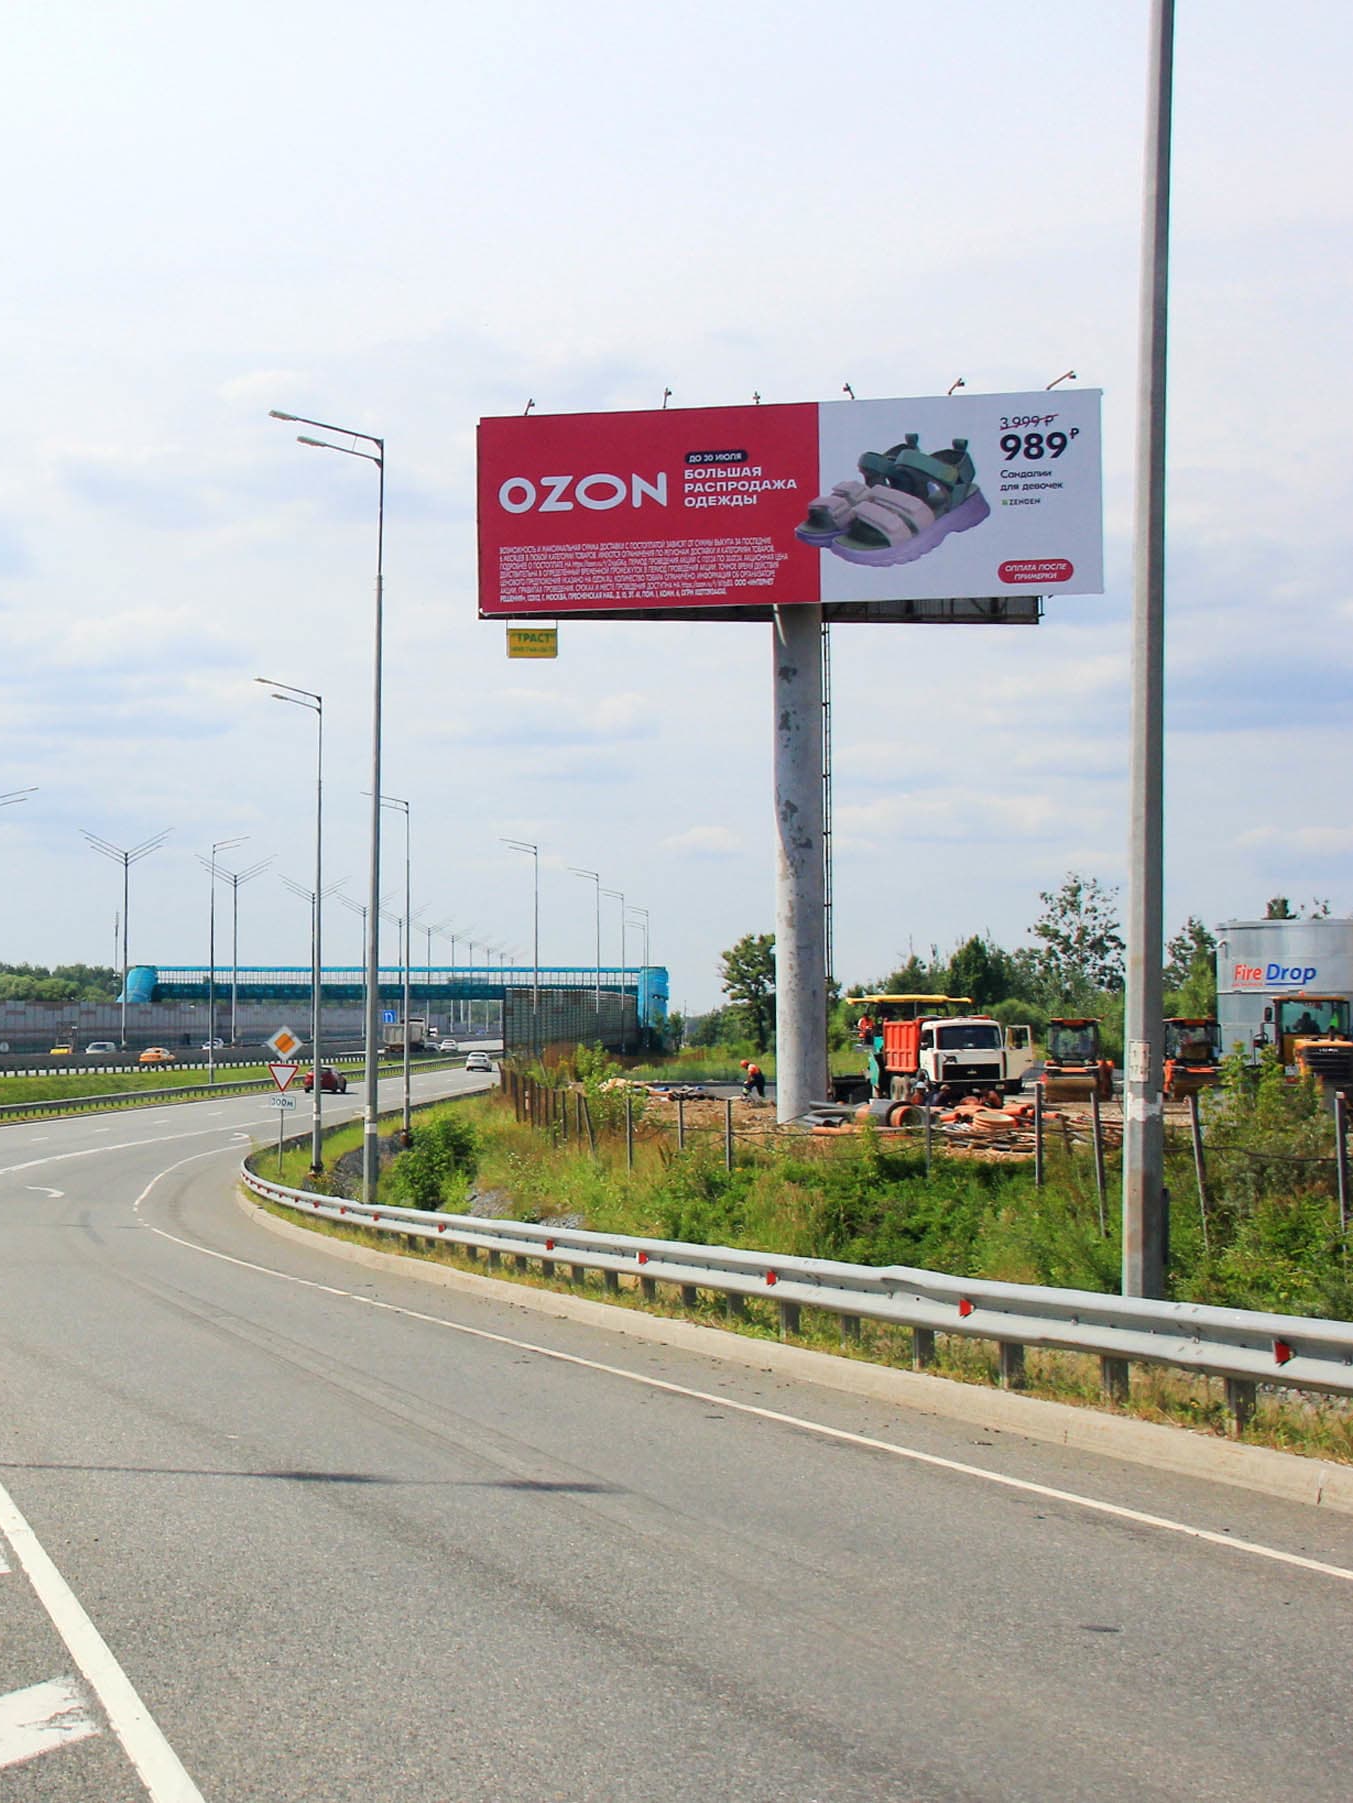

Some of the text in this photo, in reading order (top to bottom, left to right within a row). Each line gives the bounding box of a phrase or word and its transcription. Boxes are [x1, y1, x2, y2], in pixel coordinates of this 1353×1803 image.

[1000, 432, 1067, 461] 989
[689, 454, 702, 463] ДО
[715, 452, 742, 461] ИЮЛЯ
[684, 466, 762, 480] БОЛЬШАЯ
[1000, 469, 1052, 479] Сандалии
[498, 472, 667, 514] OZON
[684, 479, 797, 493] РАСПРОДАЖА
[1000, 482, 1063, 491] для девочек
[684, 494, 757, 508] ОДЕЖДЫ
[1005, 563, 1067, 572] ОПЛАТА ПОСЛЕ
[1014, 572, 1057, 581] ПРИМЕРКИ
[1234, 963, 1317, 985] Fire Drop
